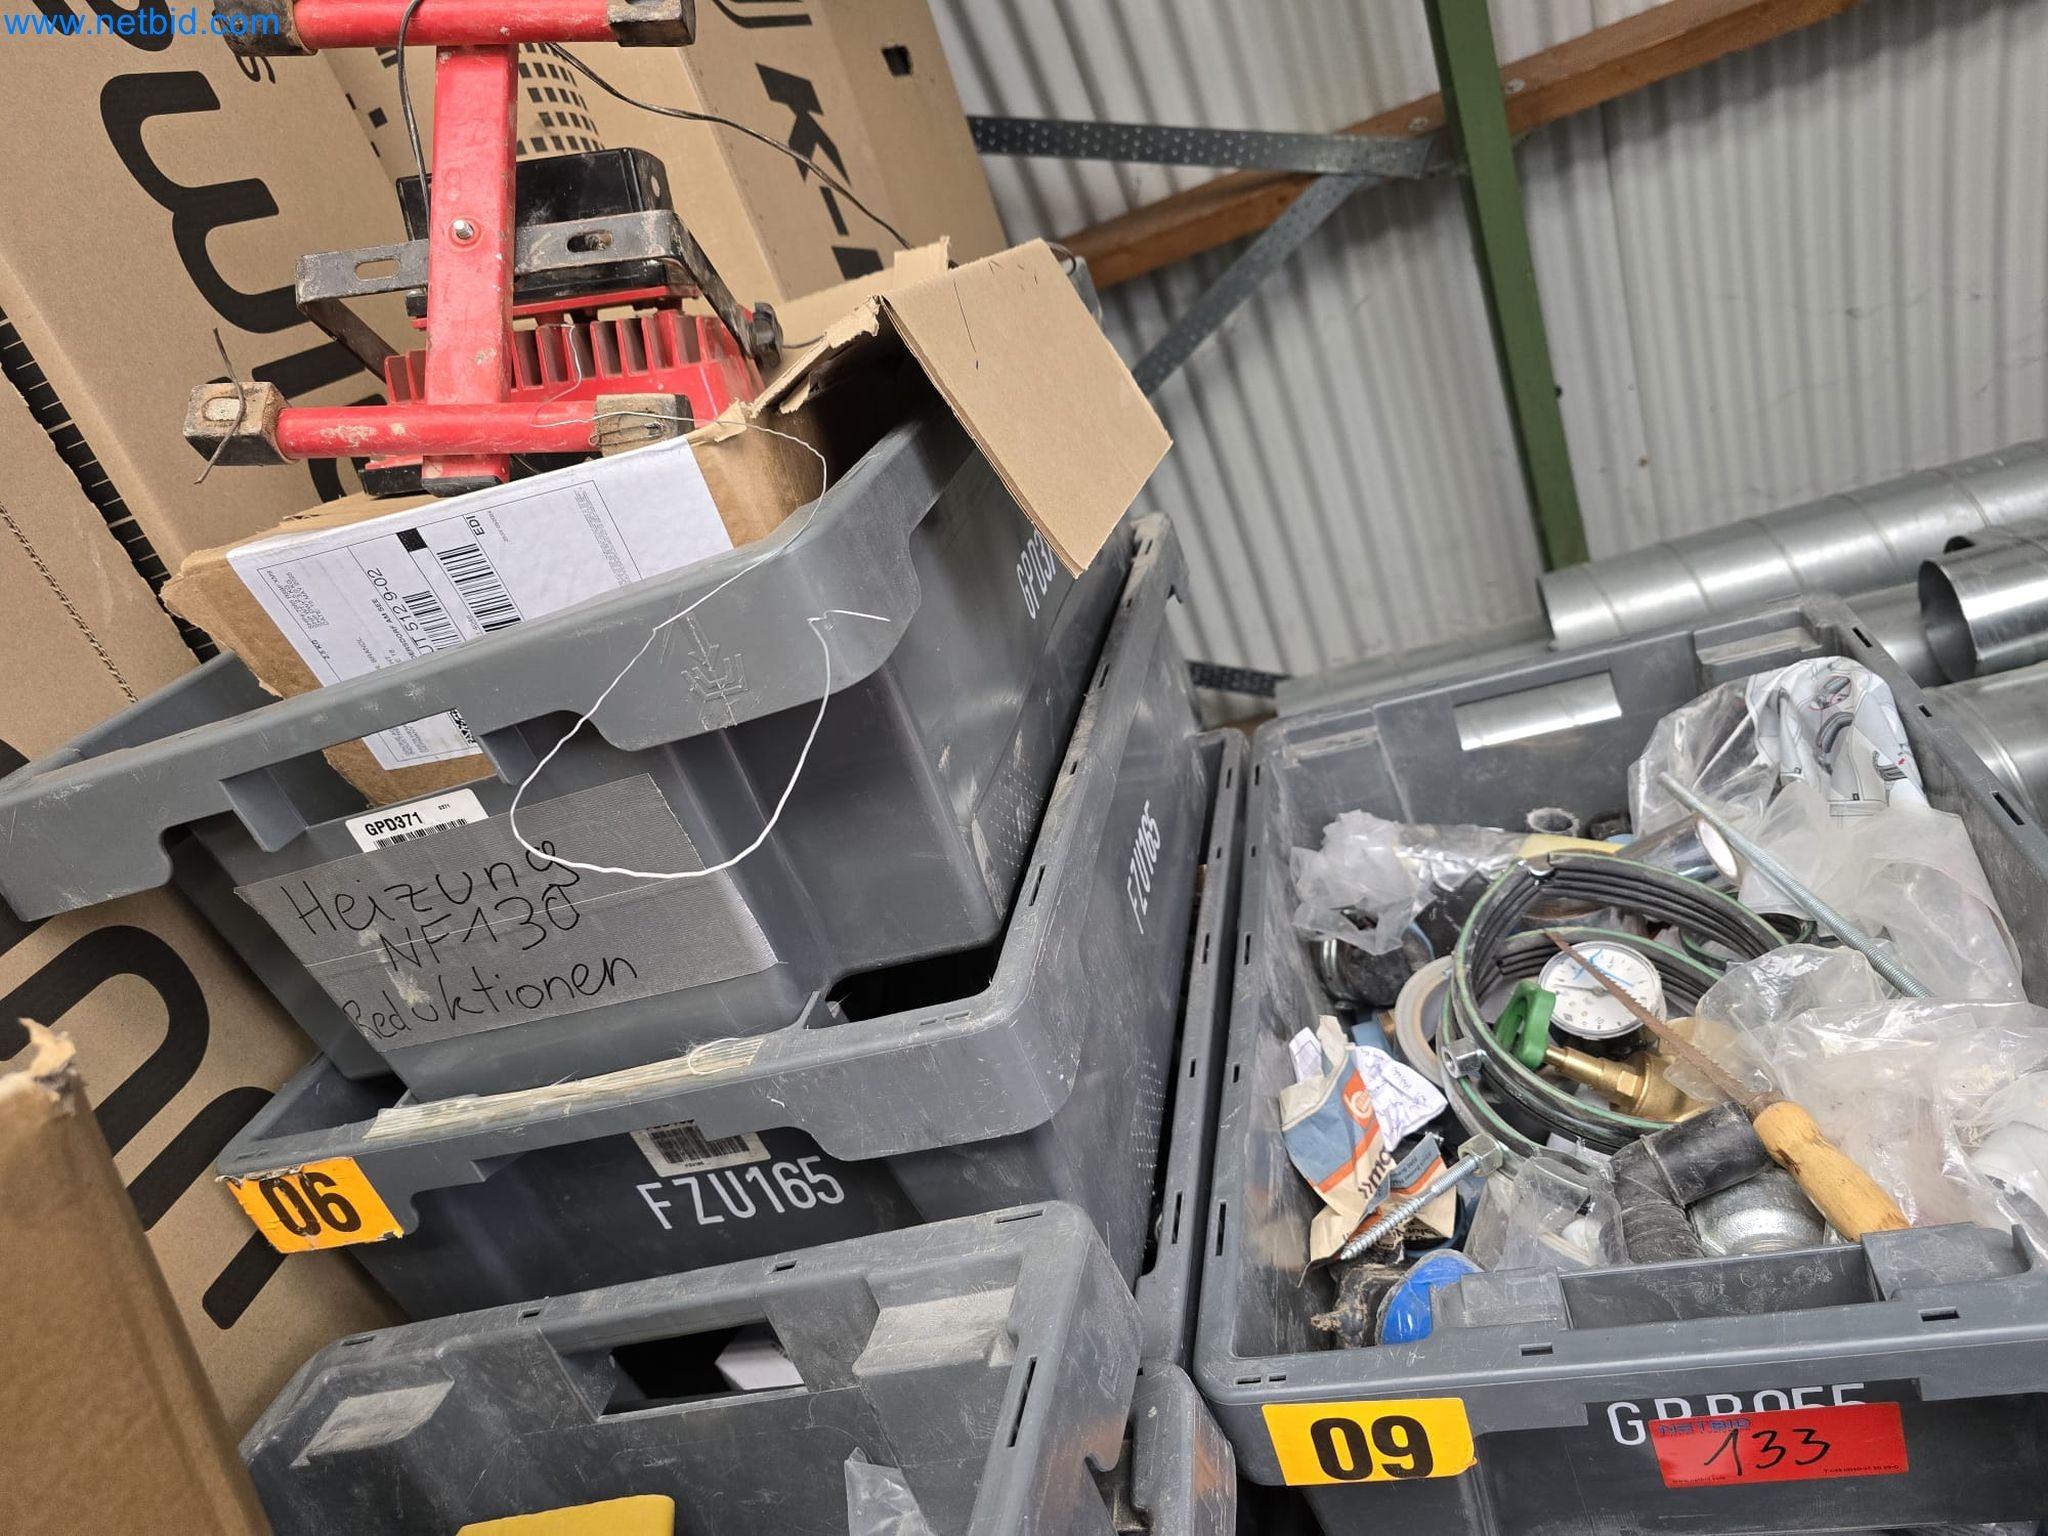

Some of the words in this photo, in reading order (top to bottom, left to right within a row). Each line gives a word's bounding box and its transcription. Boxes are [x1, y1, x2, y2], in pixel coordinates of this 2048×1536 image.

[467, 515, 485, 536] EDI
[366, 568, 398, 601] 9-02
[391, 603, 418, 631] 512
[365, 811, 423, 836] GPD371
[281, 841, 580, 936] Heizung
[1125, 799, 1161, 934] FZU165
[344, 955, 638, 1041] Reduktionen
[258, 1171, 362, 1238] 06
[636, 1155, 845, 1230] FZU165
[1308, 1413, 1436, 1481] 09
[1658, 1418, 1752, 1435] NETBID
[1703, 1427, 1831, 1477] 133
